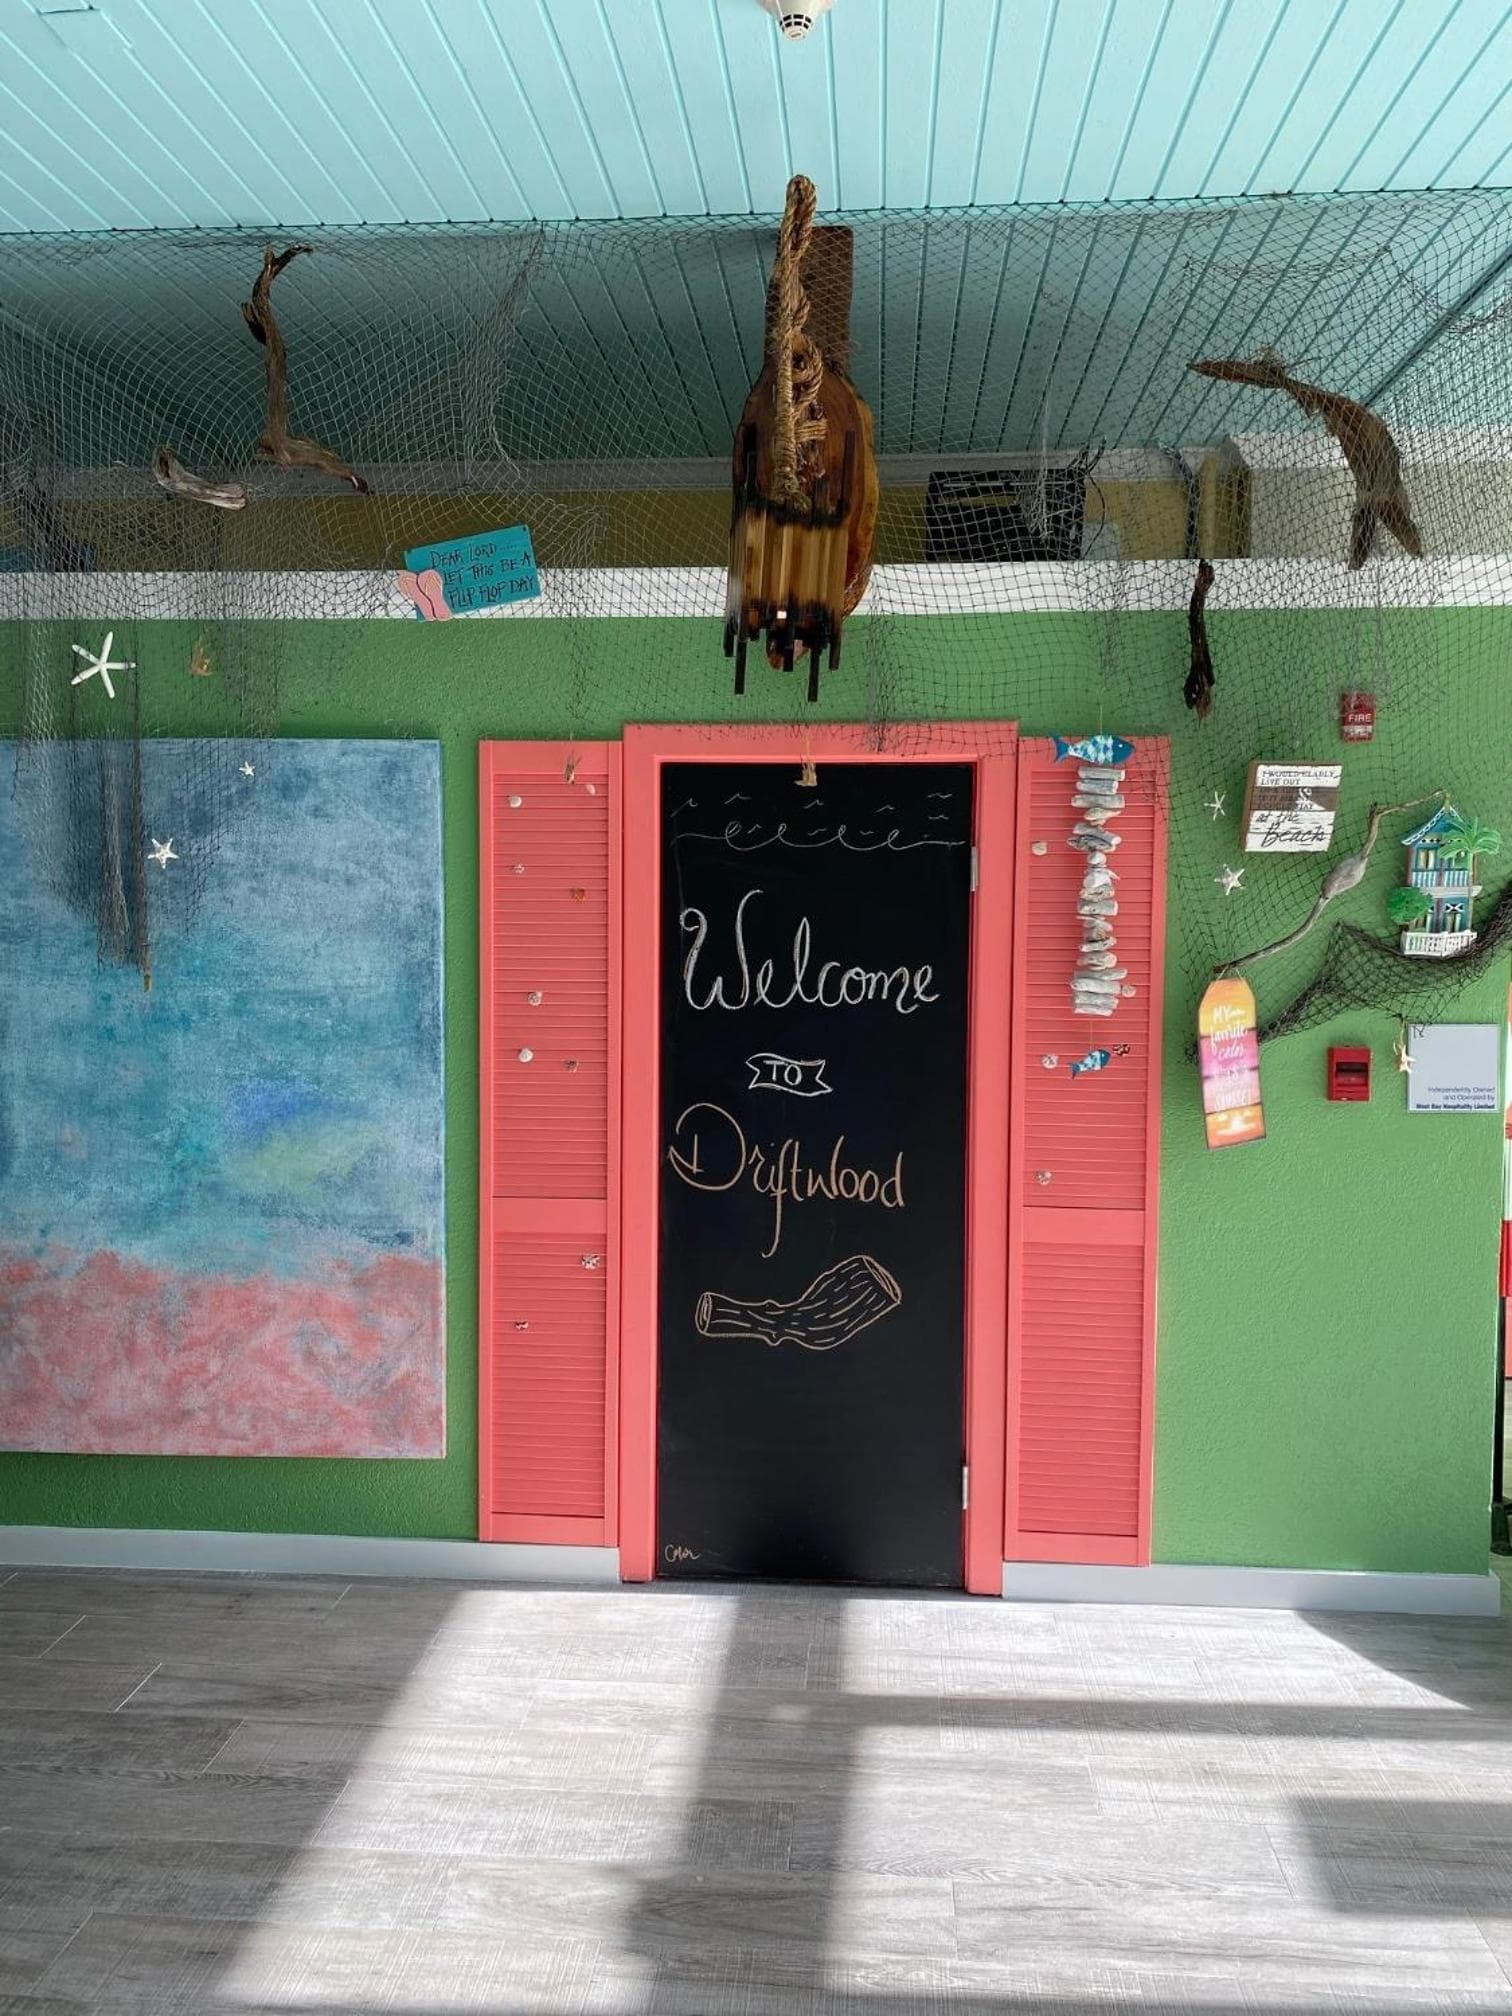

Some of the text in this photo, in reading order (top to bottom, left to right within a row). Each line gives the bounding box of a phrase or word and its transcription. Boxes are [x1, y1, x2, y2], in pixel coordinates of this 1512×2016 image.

[431, 550, 464, 568] DEAR
[444, 552, 532, 585] LET THIS BE A
[449, 576, 534, 608] FLIP FLOP DAY
[1348, 713, 1373, 723] FIRE
[1261, 822, 1326, 848] Beach
[679, 889, 939, 1013] Welcome
[763, 1059, 802, 1086] TO
